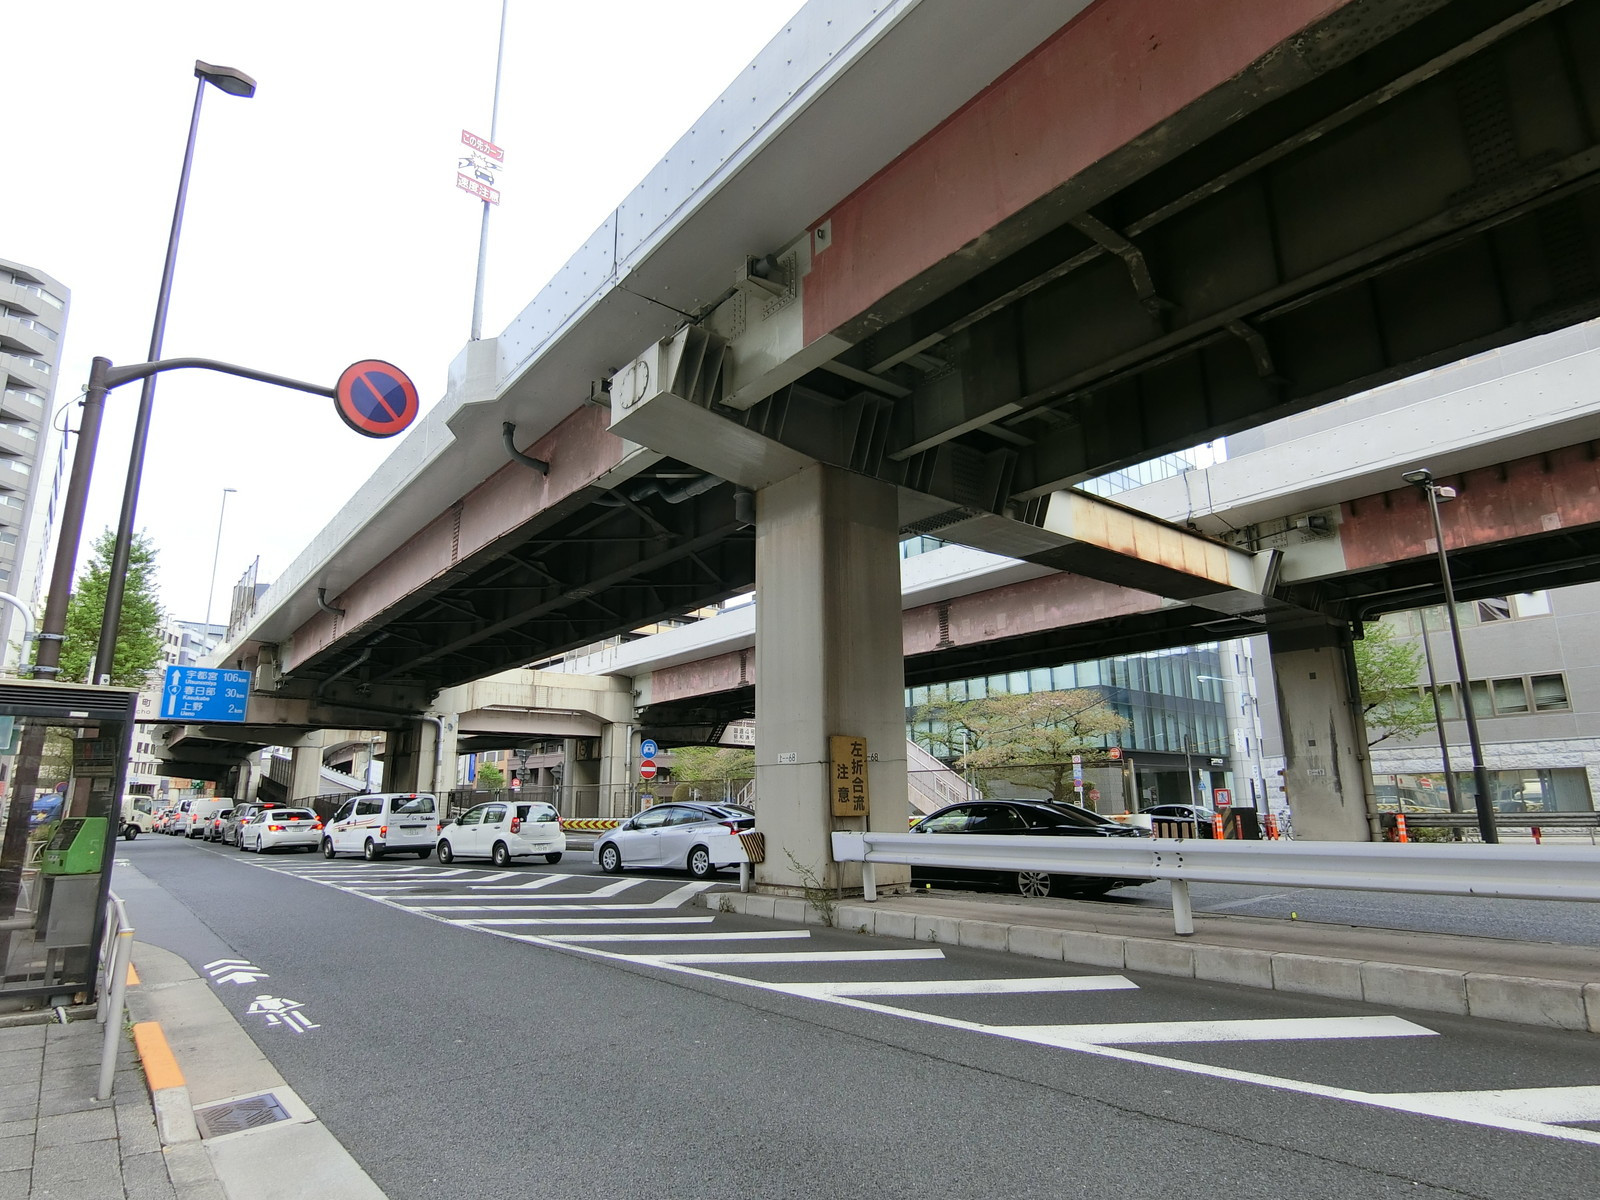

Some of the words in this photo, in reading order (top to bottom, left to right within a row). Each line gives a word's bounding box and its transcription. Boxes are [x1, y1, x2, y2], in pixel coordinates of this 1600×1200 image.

[186, 670, 218, 681] 宇都宮
[185, 679, 217, 687] Utsunomiya
[184, 686, 216, 696] 春日部
[181, 701, 204, 711] 上野
[851, 740, 865, 811] 左折合流
[837, 763, 850, 803] 注意
